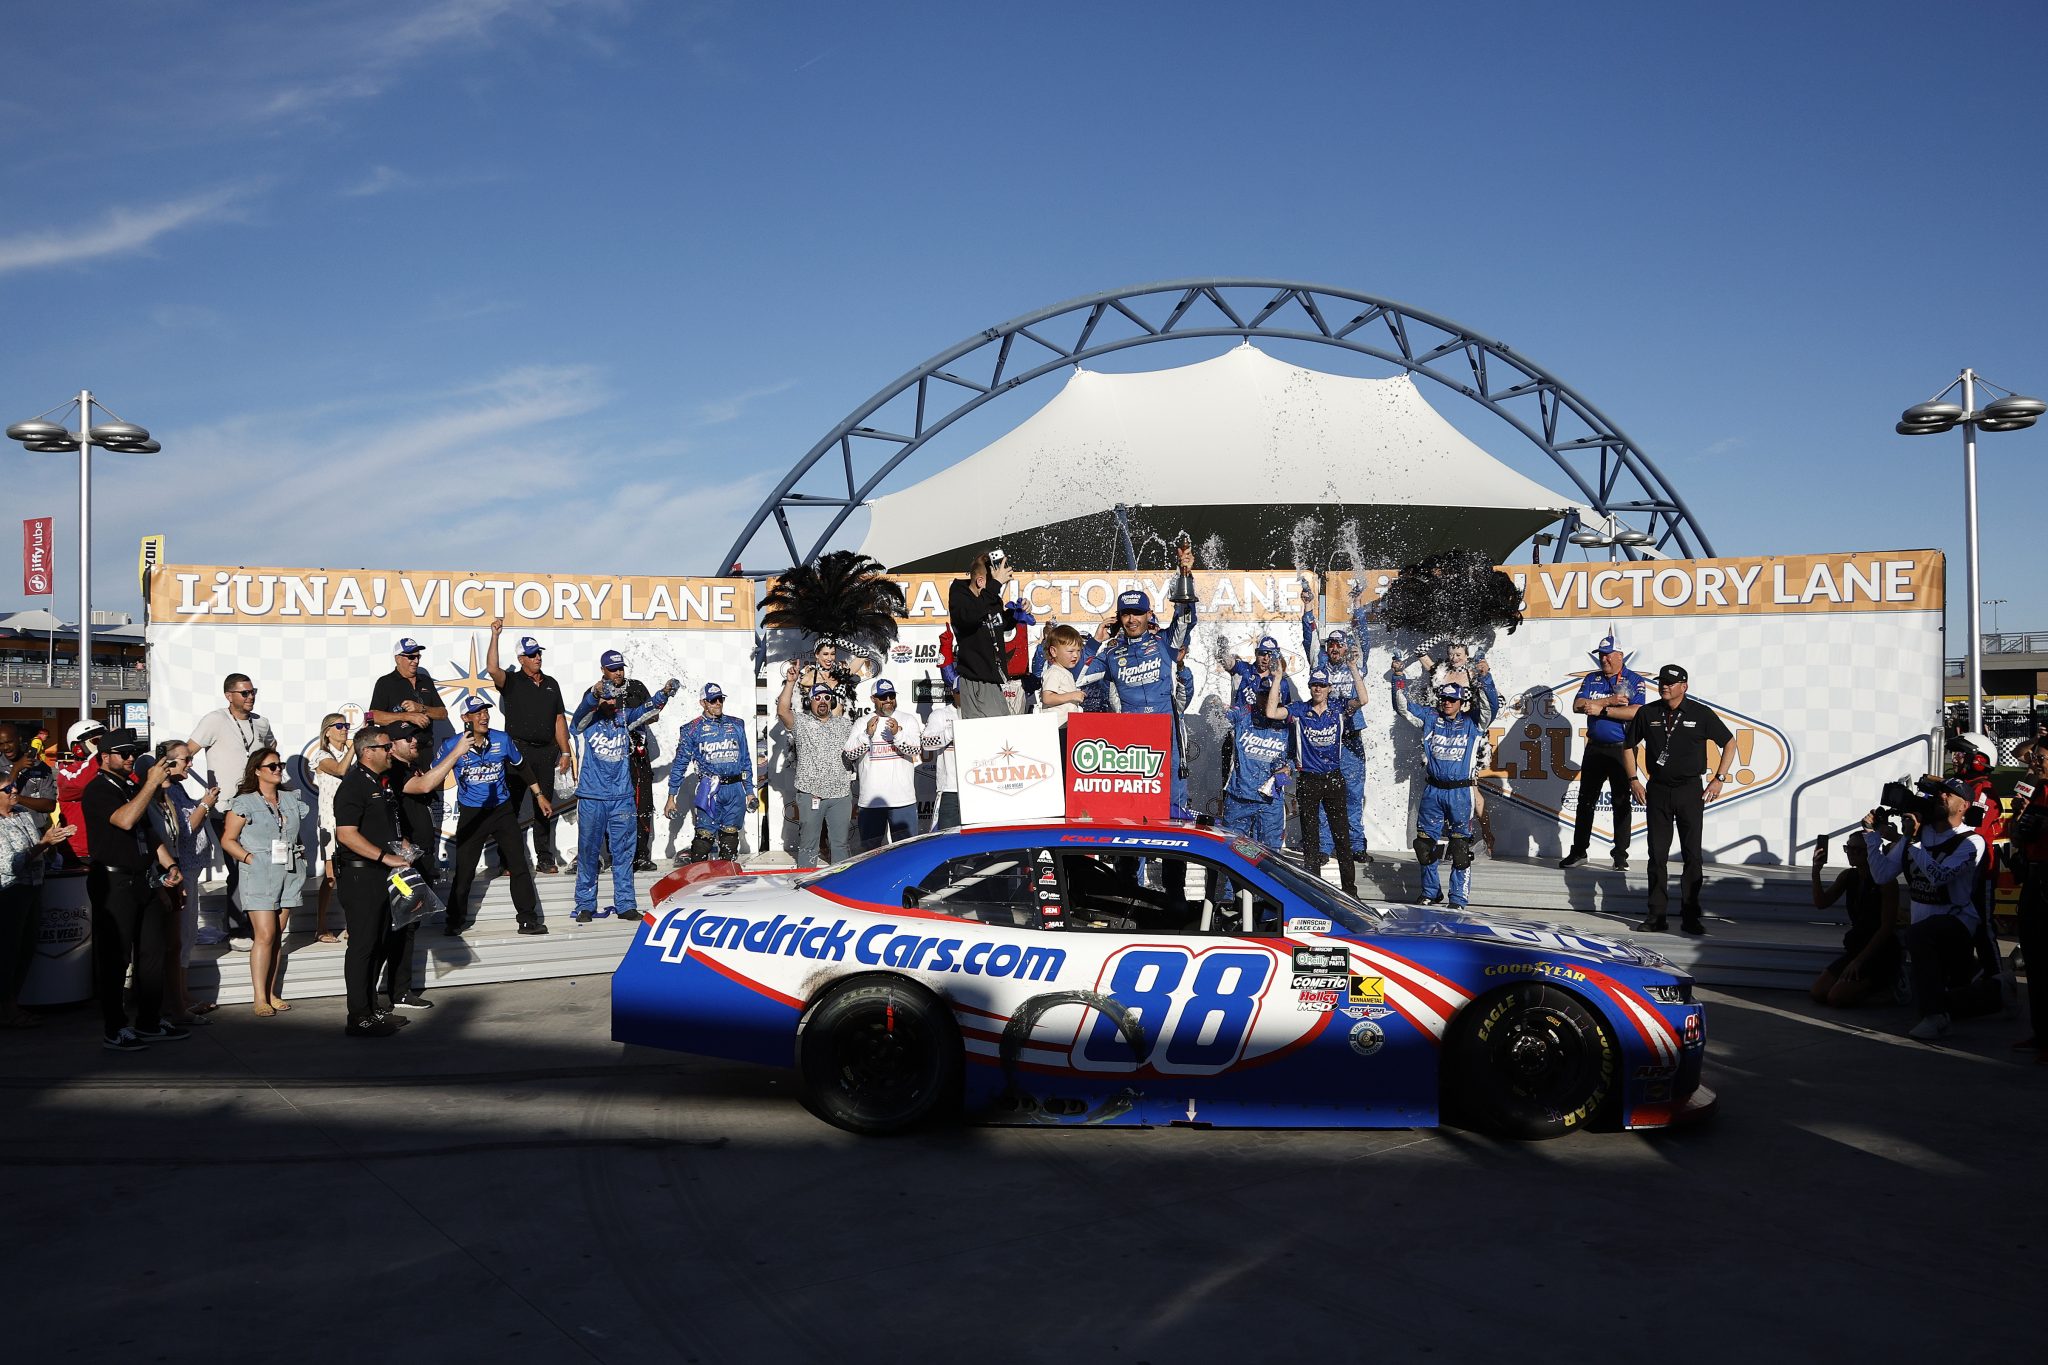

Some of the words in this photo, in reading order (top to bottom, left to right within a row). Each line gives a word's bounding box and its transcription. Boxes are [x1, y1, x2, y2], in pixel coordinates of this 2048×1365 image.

[145, 539, 157, 569] ZOIL
[1196, 577, 1303, 615] ANE
[1539, 565, 1764, 610] VICTORY
[1773, 560, 1916, 605] LANE
[175, 571, 388, 618] LiUNA!
[400, 577, 613, 621] VICTORY
[621, 584, 737, 623] LANE
[914, 645, 937, 658] LAS
[1118, 657, 1161, 681] Hendrick
[1126, 669, 1160, 684] Cars.com
[1076, 743, 1159, 775] O'Reilly
[973, 763, 1047, 785] LiUNA!
[1073, 778, 1112, 793] AUTO
[1114, 778, 1162, 794] PARTS
[2015, 783, 2032, 794] PRN
[1293, 976, 1347, 990] COMETIC
[1083, 950, 1271, 1066] 88
[1298, 1002, 1333, 1012] MSD
[1299, 990, 1339, 1005] Holley
[1477, 994, 1516, 1043] EAGLE
